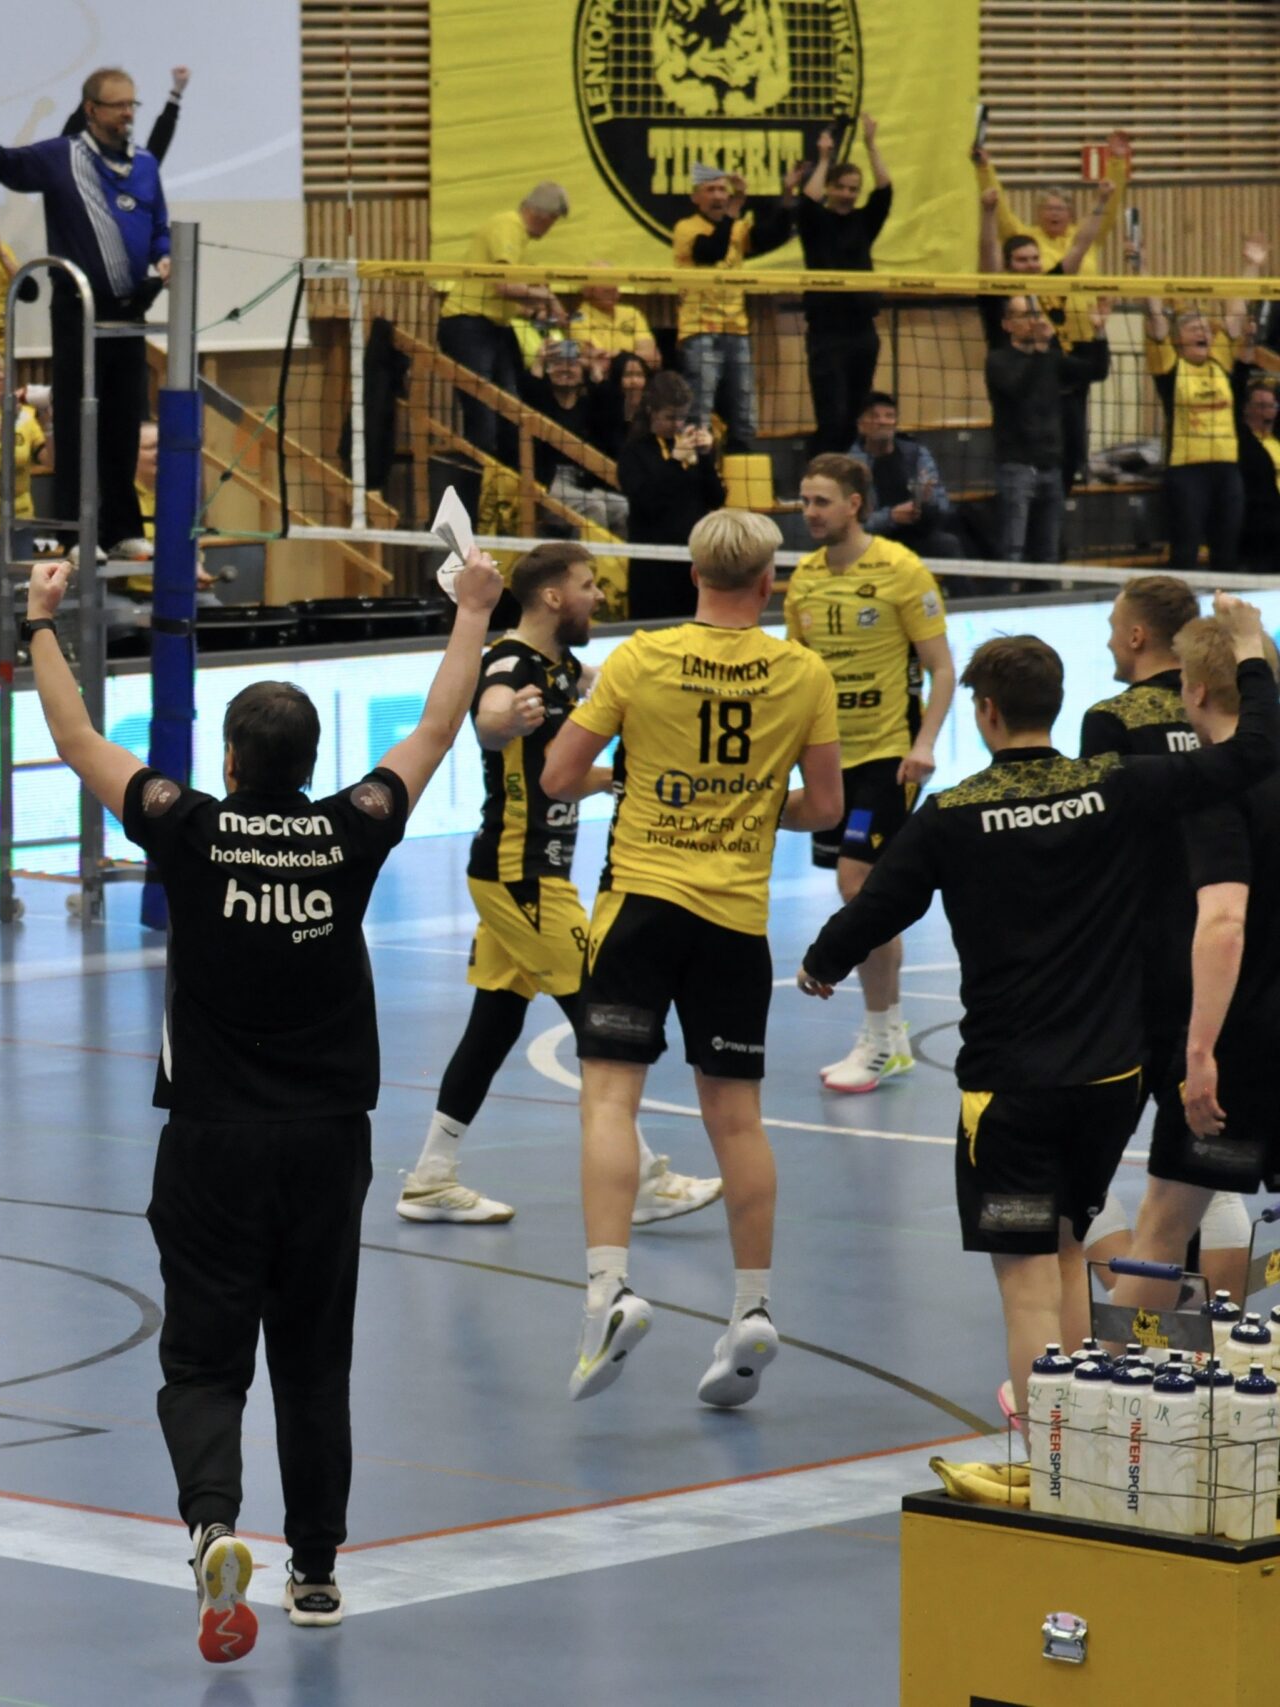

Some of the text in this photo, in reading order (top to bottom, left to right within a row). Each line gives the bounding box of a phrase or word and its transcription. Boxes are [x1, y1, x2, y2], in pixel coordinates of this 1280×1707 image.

[827, 604, 843, 635] 11
[697, 699, 752, 765] 18
[220, 811, 333, 836] macron
[981, 791, 1106, 833] macron
[210, 844, 345, 867] hotelkokkola.fi
[223, 878, 334, 924] hilla
[292, 922, 334, 943] group
[1050, 1409, 1062, 1501] INTERSPORT
[1128, 1420, 1142, 1513] INTERSPORT
